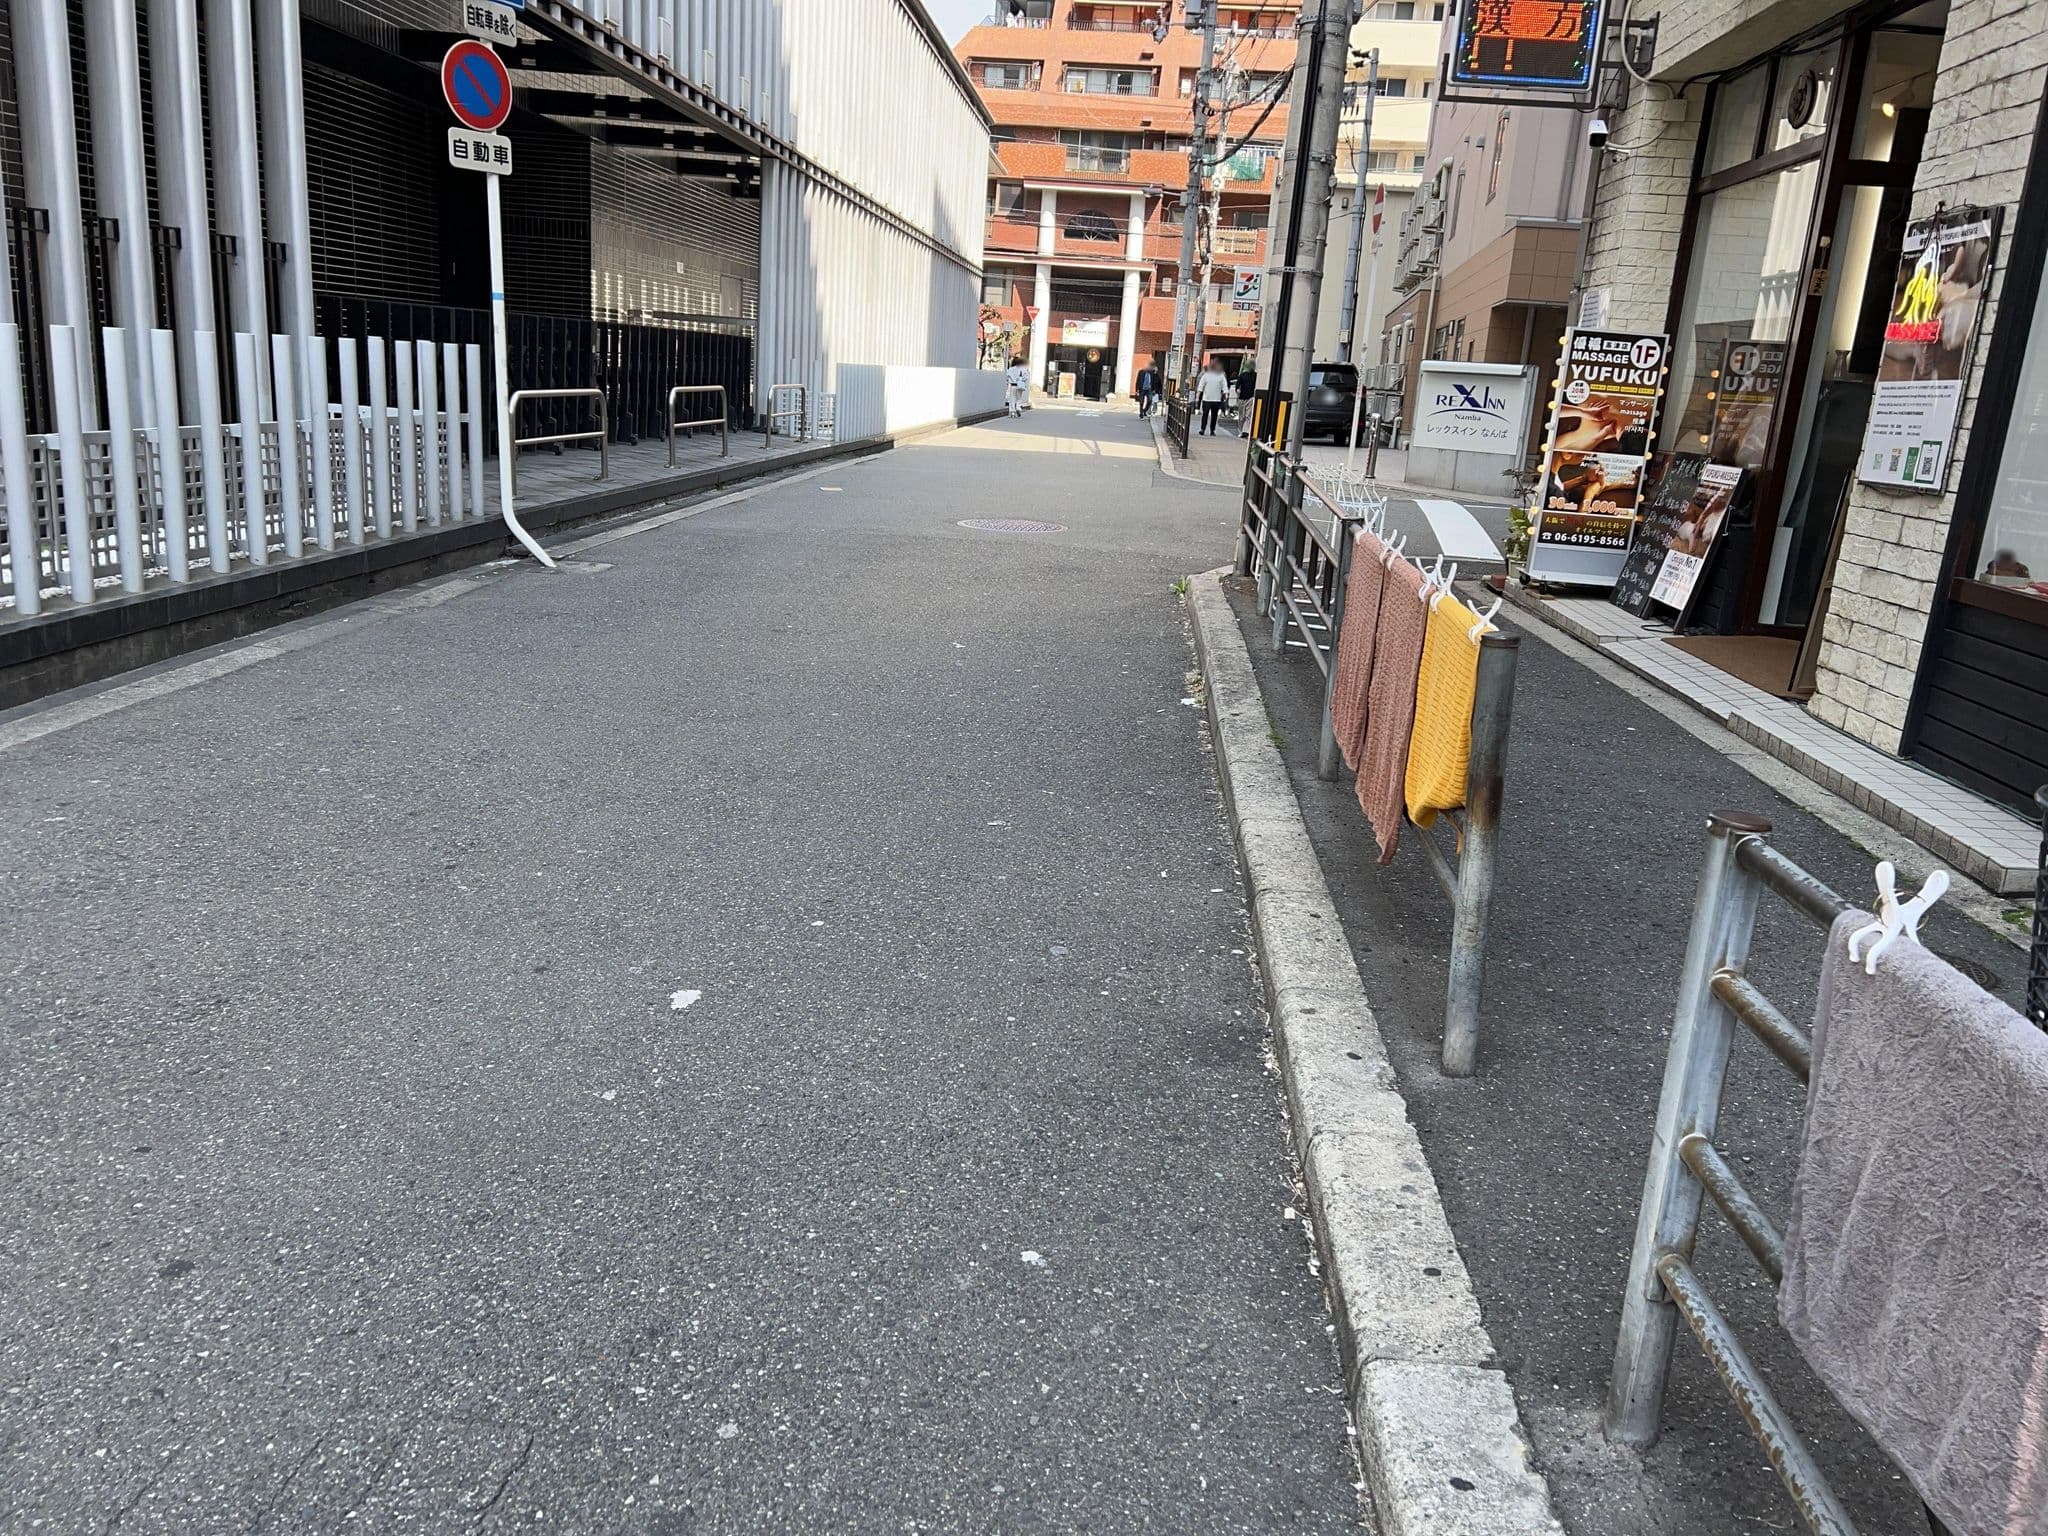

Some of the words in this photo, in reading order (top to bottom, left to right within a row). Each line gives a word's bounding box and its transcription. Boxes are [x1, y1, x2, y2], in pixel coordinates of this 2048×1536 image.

[466, 5, 516, 38] 自転車を除く
[1477, 0, 1580, 38] 漢方
[453, 138, 510, 166] 自動車
[1571, 350, 1630, 364] MASSAGE
[1635, 345, 1657, 365] 1F
[1571, 364, 1658, 386] YUFUKU
[1619, 409, 1648, 417] massage
[1427, 424, 1478, 436] レックスイン
[1480, 429, 1509, 439] なんば
[1554, 532, 1625, 546] 06-6195-8566
